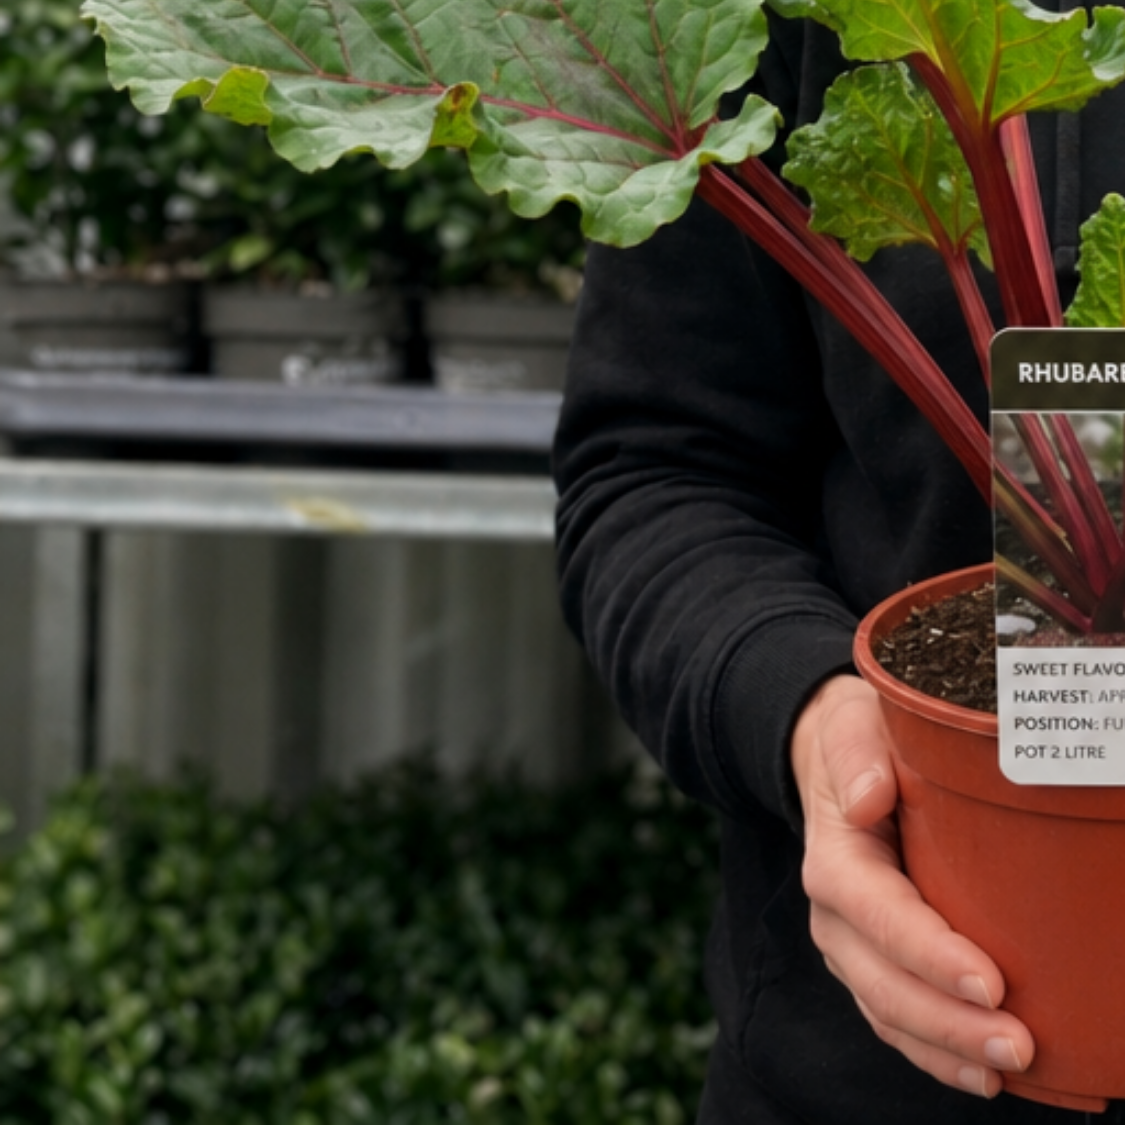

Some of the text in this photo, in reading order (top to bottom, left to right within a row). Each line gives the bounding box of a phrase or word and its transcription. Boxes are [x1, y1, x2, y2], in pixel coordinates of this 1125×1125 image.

[1013, 662, 1068, 676] SWEET
[1013, 689, 1093, 704] HARVEST:
[1014, 716, 1099, 731] POSITION:
[1014, 744, 1105, 759] POT 2 LITRE
